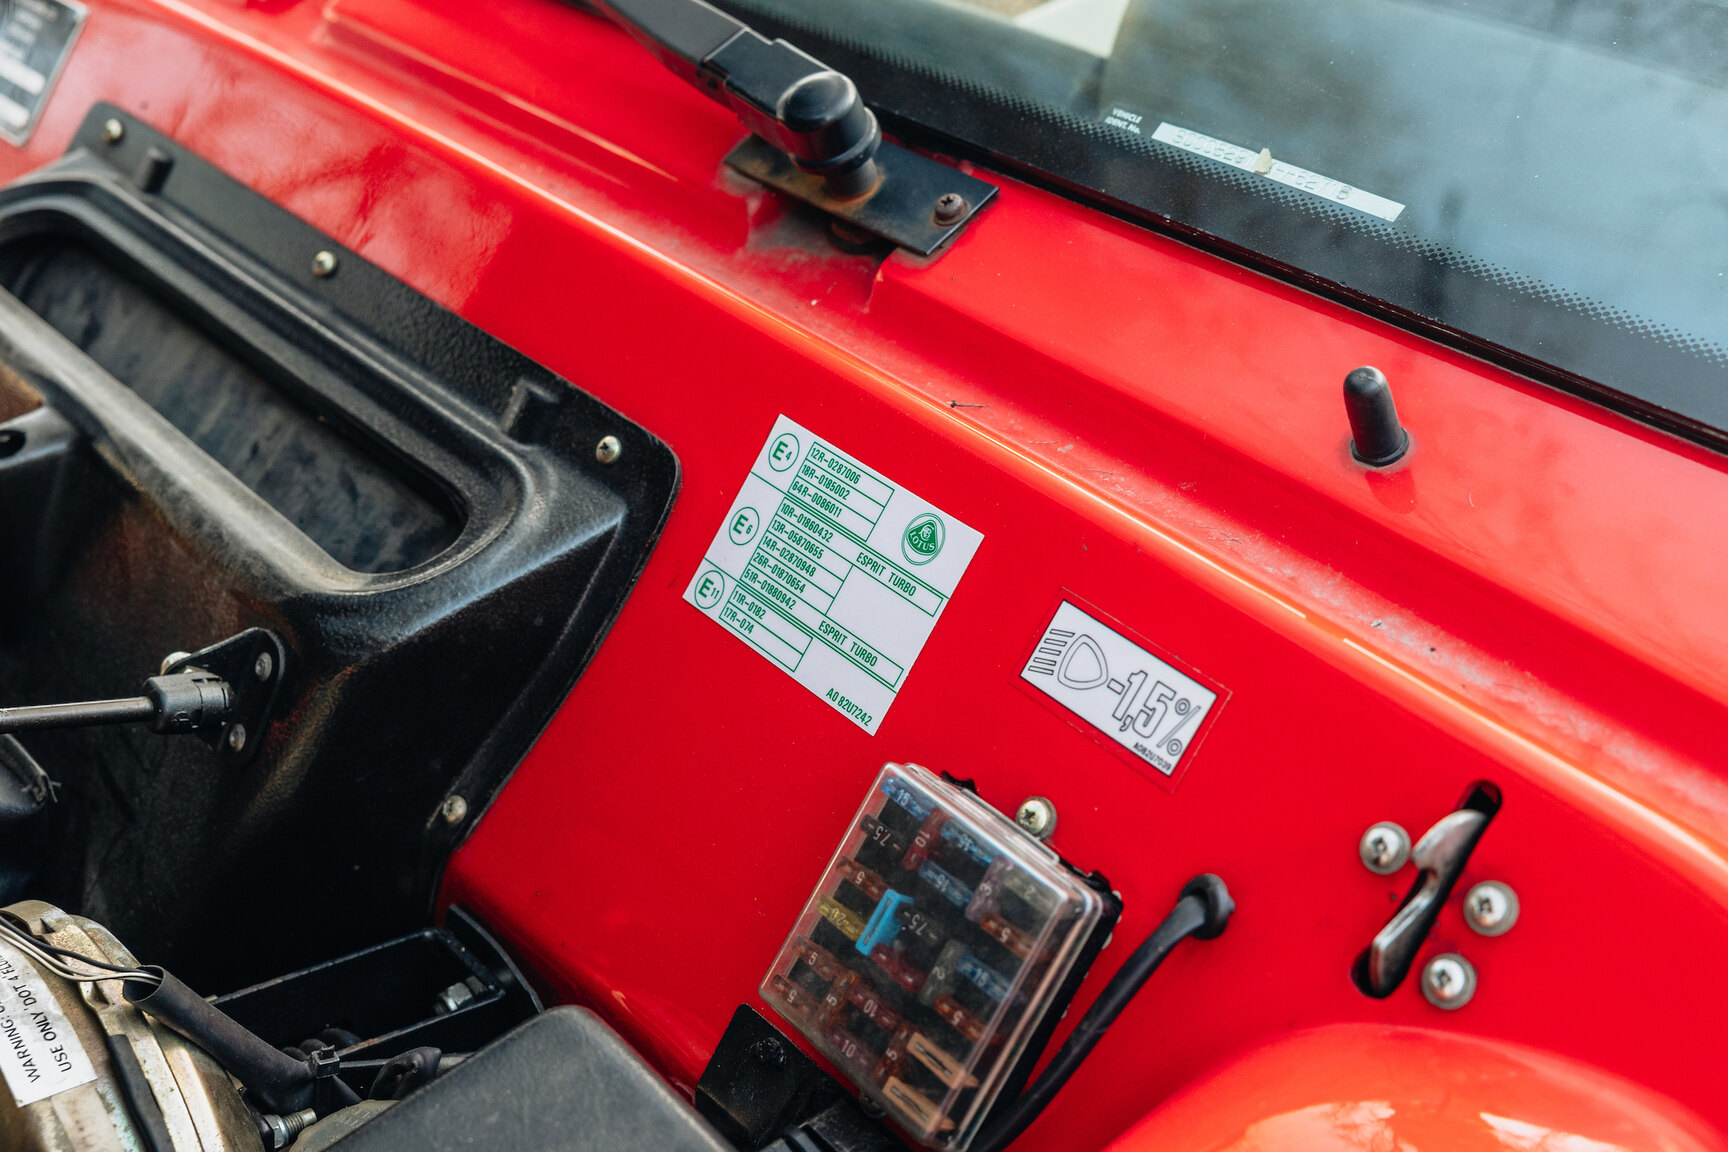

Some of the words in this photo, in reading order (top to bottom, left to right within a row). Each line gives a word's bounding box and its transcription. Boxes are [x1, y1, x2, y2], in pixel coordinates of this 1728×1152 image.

[1112, 107, 1143, 124] VEHICLE
[810, 447, 861, 485] 12R-0287006
[801, 464, 851, 501] 18R-0185002
[792, 480, 843, 518] 64R-0086011
[780, 503, 834, 543] 10R-01860432
[771, 519, 825, 560] 13R-05870655
[910, 531, 936, 551] LOTUS
[762, 536, 817, 578] 14R-02870948
[752, 552, 806, 594] 26R-01870654
[856, 551, 887, 576] ESPRIT
[887, 571, 917, 597] TURBO
[743, 569, 797, 611] 51R-01880942
[732, 590, 767, 621] 11R-0182
[723, 606, 755, 635] 17R-074
[818, 620, 848, 646] ESPRIT
[849, 641, 878, 667] TURBO
[837, 695, 873, 727] 82U7242
[896, 788, 911, 806] 15
[915, 830, 931, 848] 10
[854, 870, 866, 885] 5
[1000, 927, 1012, 944] 5
[808, 951, 818, 966] 5
[826, 993, 838, 1007] 5
[863, 999, 879, 1019] 10
[30, 1011, 57, 1042] ONLY
[951, 1009, 964, 1026] 5
[50, 1044, 73, 1073] USE
[841, 1039, 857, 1058] 10
[885, 1047, 899, 1062] 5
